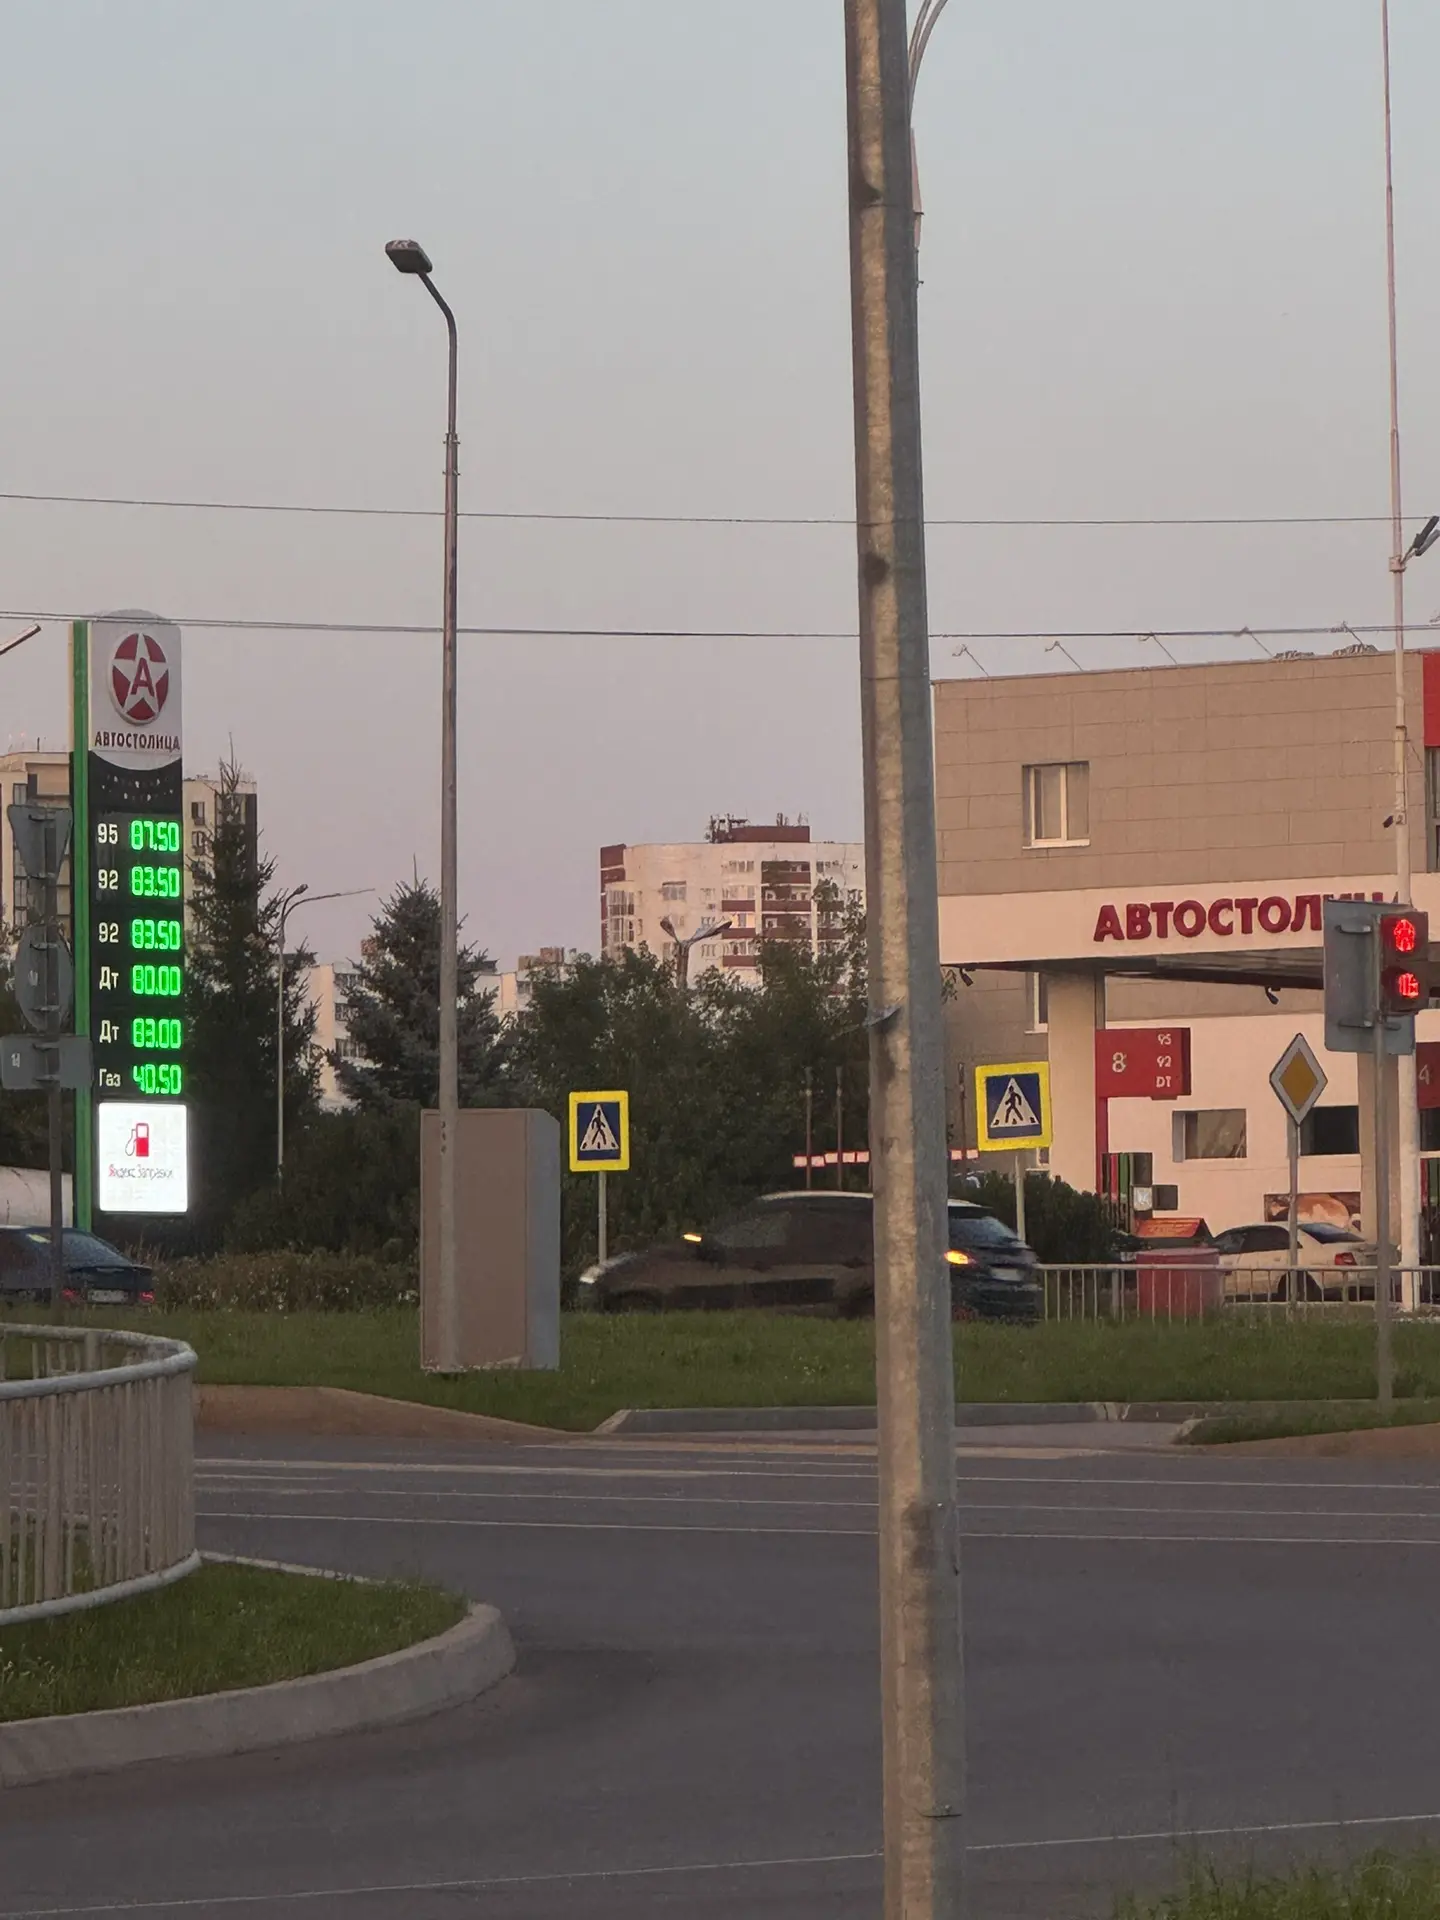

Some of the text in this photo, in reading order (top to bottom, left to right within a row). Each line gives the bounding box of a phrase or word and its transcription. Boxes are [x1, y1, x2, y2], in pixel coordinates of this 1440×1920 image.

[95, 731, 180, 750] АВТОСТОЛИЦА
[97, 822, 119, 845] 95
[98, 866, 181, 898] 92 83.50
[1093, 892, 1399, 942] АВТОСТОЛ
[98, 919, 182, 950] 92 83.50
[99, 965, 120, 990] Дт
[99, 1019, 120, 1043] Дт
[1157, 1033, 1172, 1046] 95
[1111, 1052, 1127, 1074] 8
[1156, 1055, 1172, 1068] 92
[99, 1064, 183, 1095] Газ 40.50
